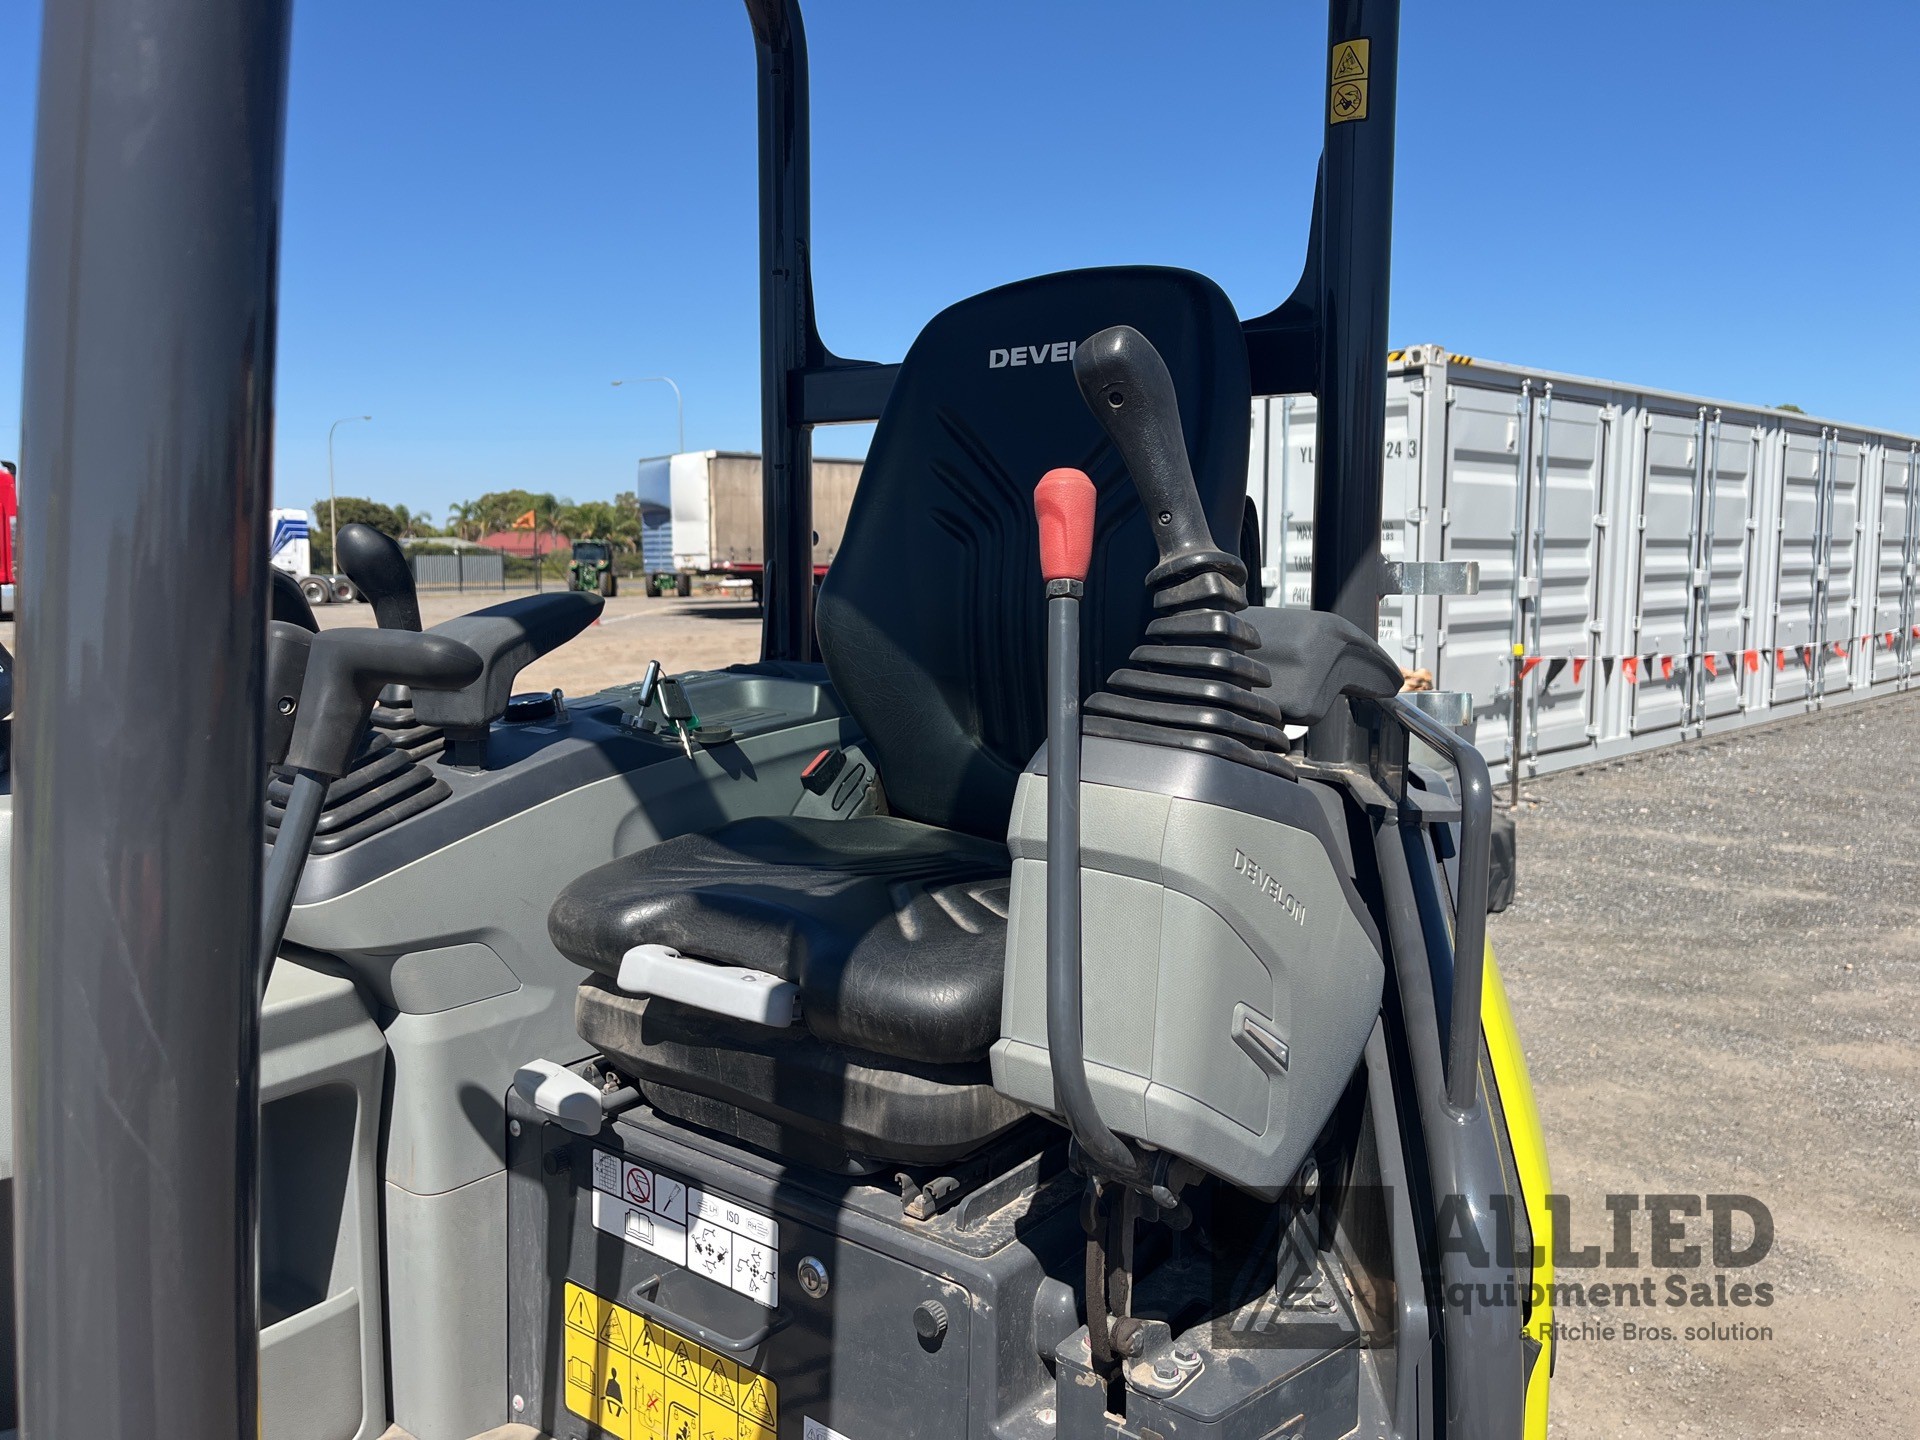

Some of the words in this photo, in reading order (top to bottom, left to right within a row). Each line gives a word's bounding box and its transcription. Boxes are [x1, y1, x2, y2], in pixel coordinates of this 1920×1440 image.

[989, 341, 1077, 369] DEVEL
[1233, 848, 1306, 926] DEVELON
[709, 1204, 718, 1214] LH
[726, 1210, 740, 1225] ISO
[747, 1220, 757, 1230] RH
